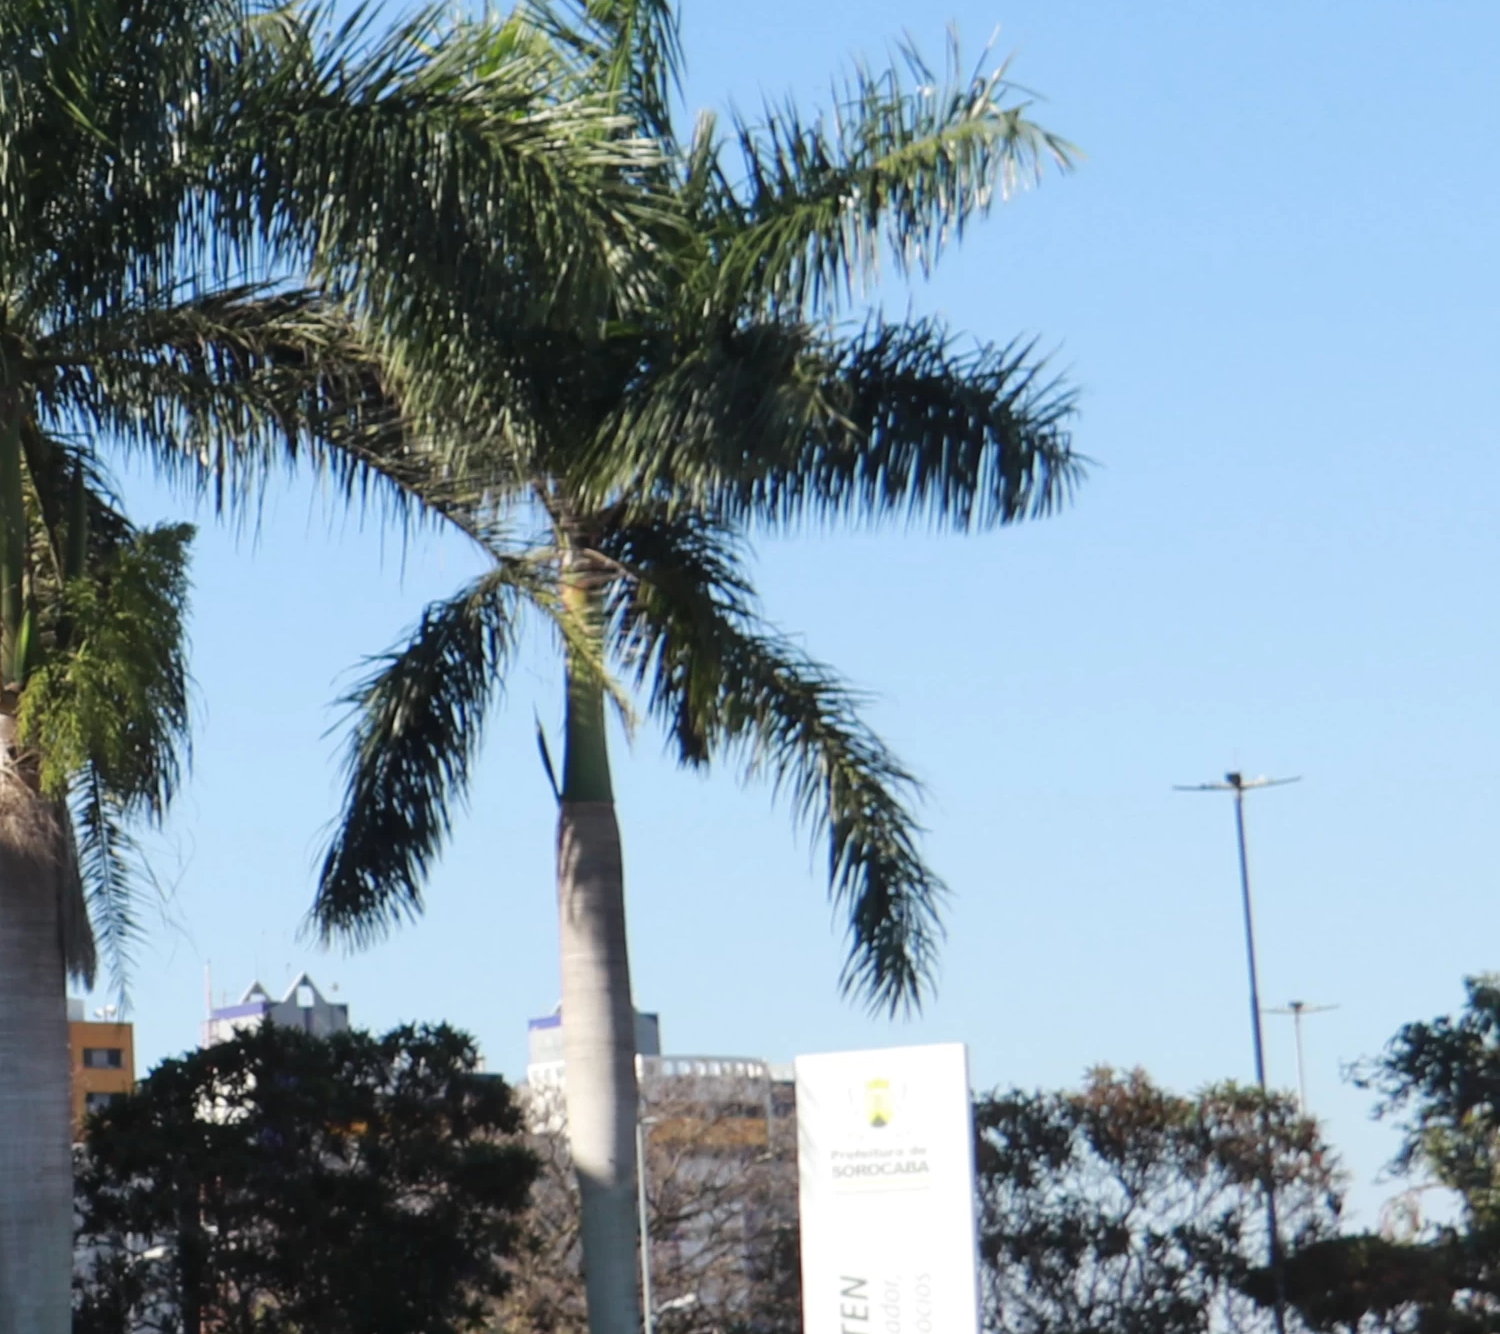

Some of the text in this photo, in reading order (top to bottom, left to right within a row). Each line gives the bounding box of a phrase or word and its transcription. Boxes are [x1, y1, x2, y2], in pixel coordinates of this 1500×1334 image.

[830, 1144, 927, 1161] Prefeitura de
[831, 1160, 930, 1179] SOROCABA
